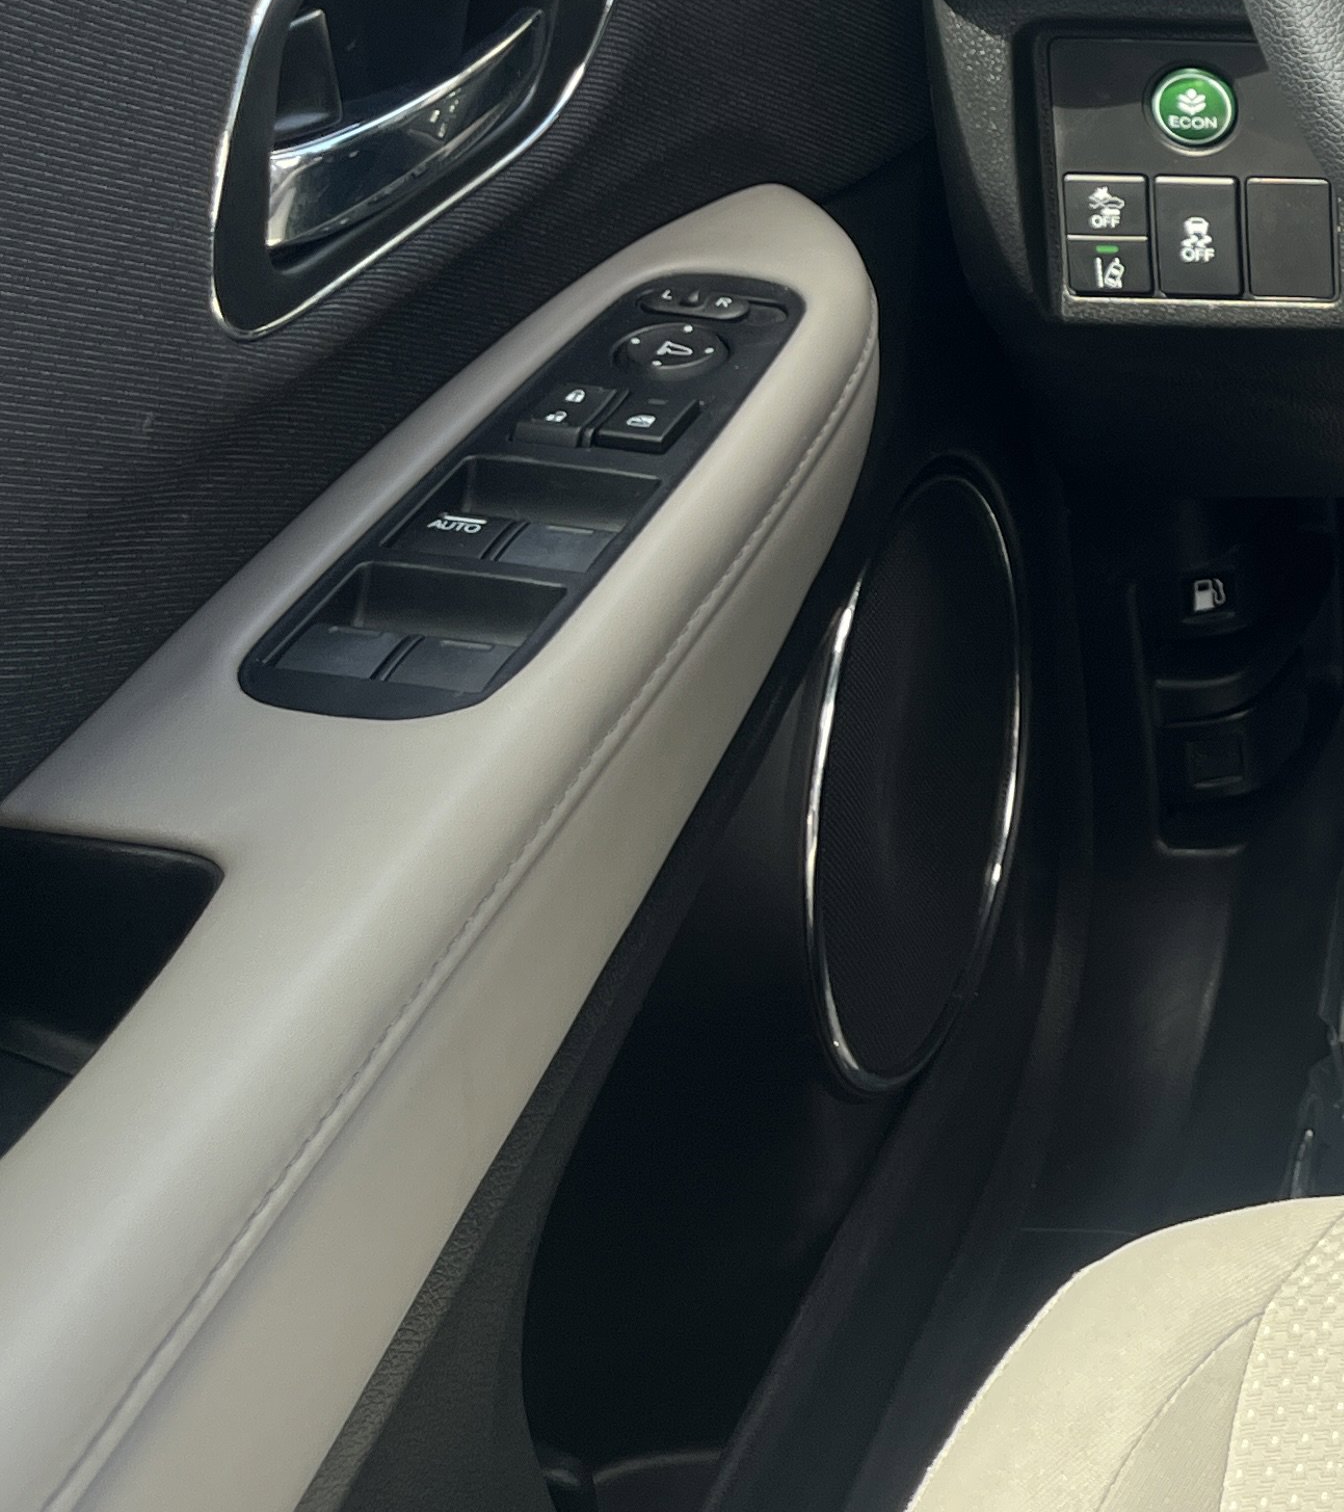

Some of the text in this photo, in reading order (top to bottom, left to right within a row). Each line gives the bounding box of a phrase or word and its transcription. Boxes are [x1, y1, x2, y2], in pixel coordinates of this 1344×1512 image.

[1168, 115, 1218, 130] ECON
[1090, 215, 1121, 229] OFF
[1180, 248, 1215, 263] OFF
[427, 518, 483, 534] AUTO
